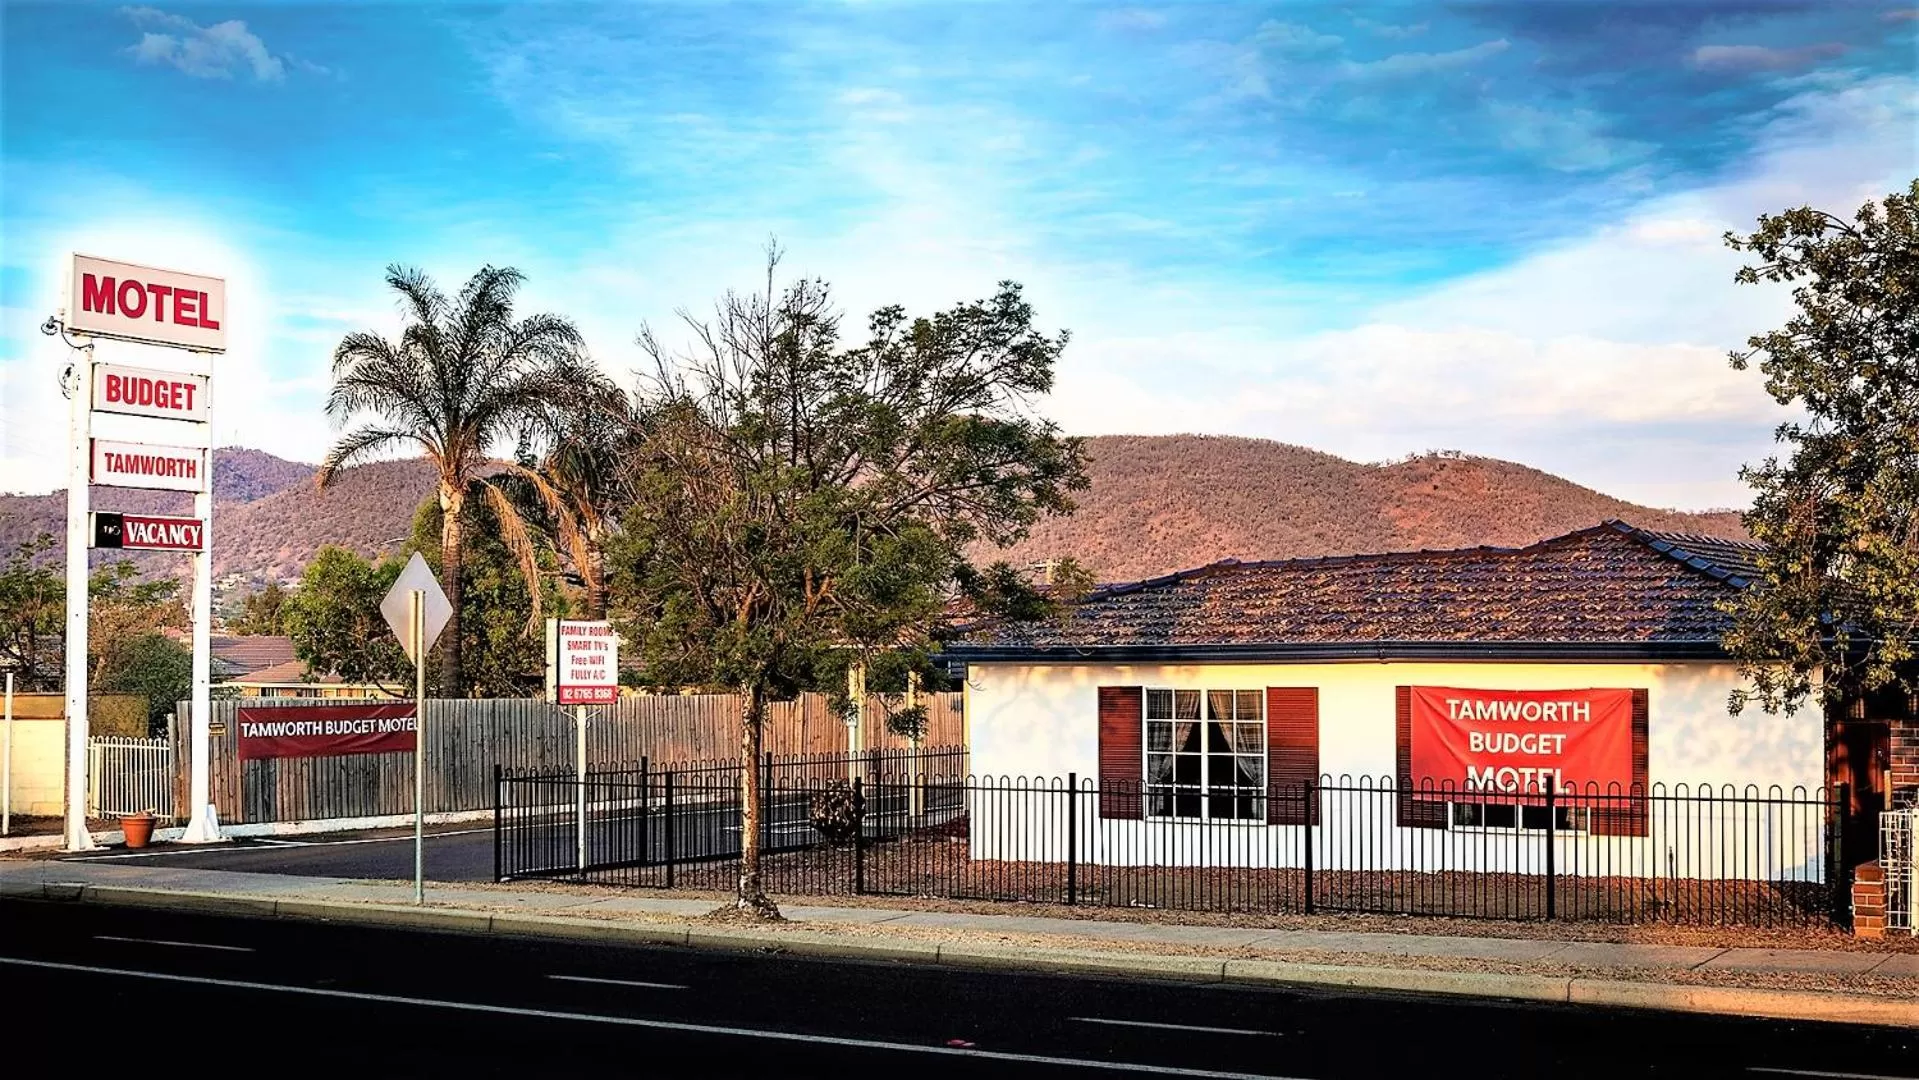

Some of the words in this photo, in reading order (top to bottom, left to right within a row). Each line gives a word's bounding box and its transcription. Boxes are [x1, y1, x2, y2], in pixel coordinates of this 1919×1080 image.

[82, 273, 220, 331] MOTEL
[106, 374, 197, 411] BUDGET
[104, 452, 197, 479] TAMWORTH
[125, 521, 202, 546] VACANCY
[561, 625, 587, 636] FAMILY
[567, 640, 592, 651] SMART
[571, 654, 587, 665] Free
[571, 669, 592, 680] FULLY
[1445, 699, 1590, 722] TAMWORTH
[241, 720, 323, 738] TAMWORTH
[325, 718, 376, 735] BUDGET
[378, 717, 418, 733] MOTEL
[1469, 731, 1567, 754] BUDGET
[1467, 765, 1571, 794] MOTEL
